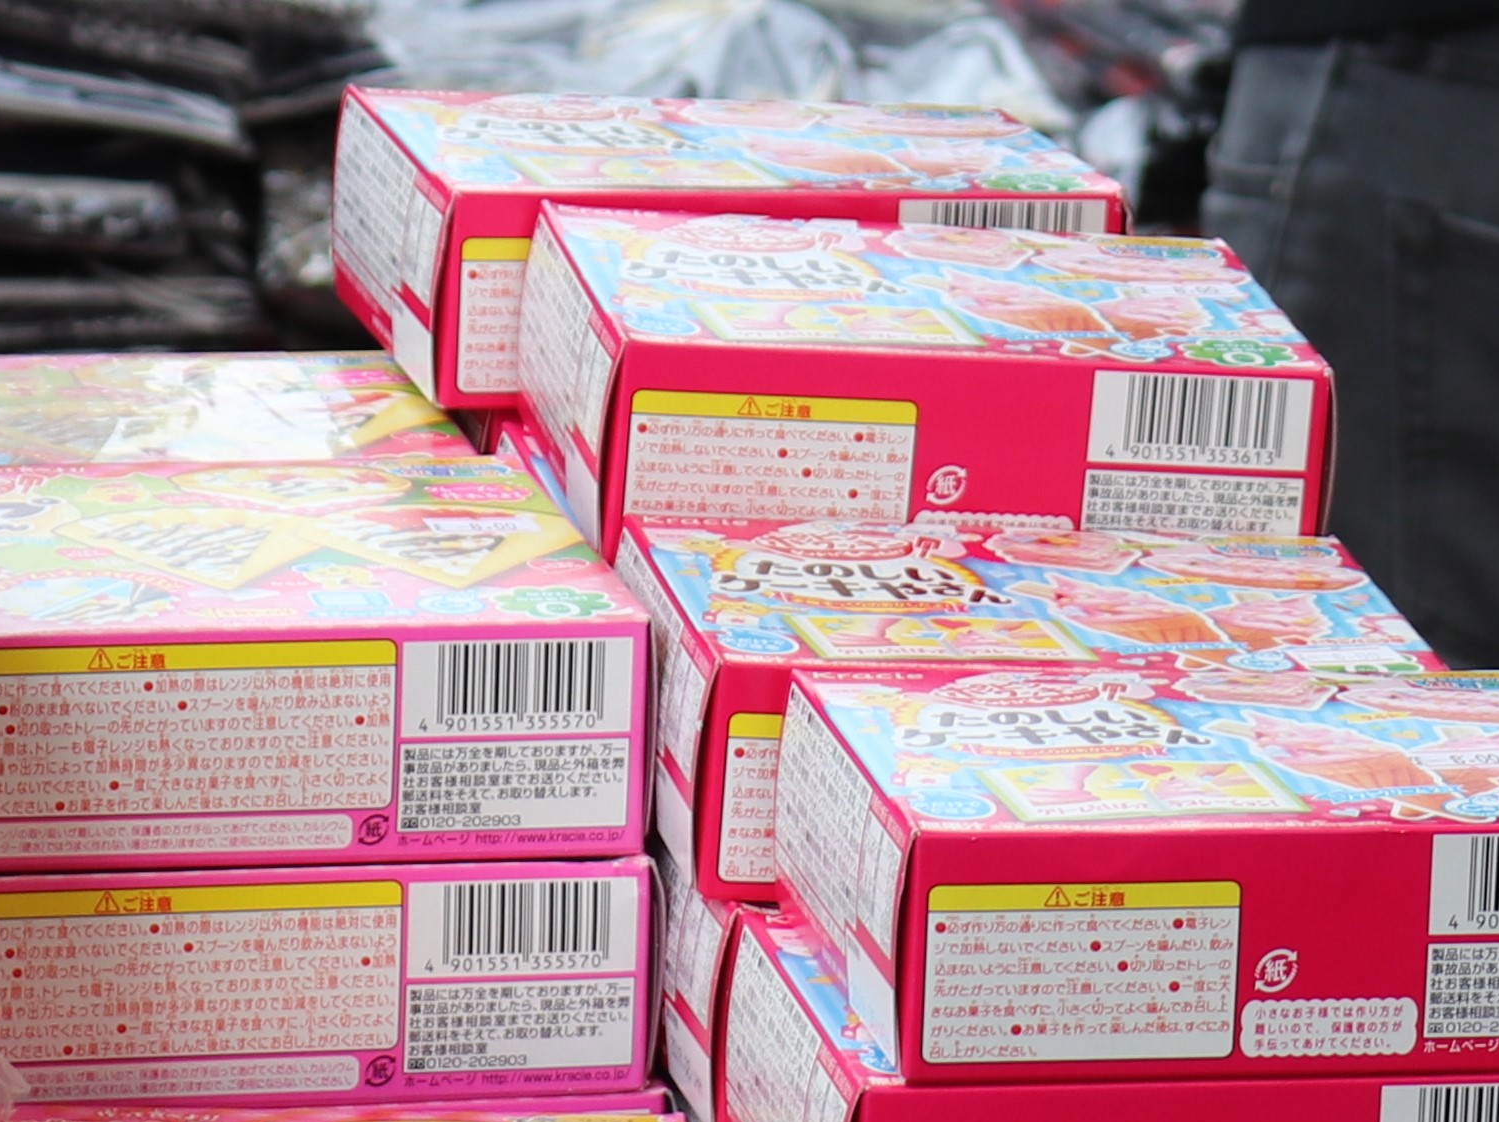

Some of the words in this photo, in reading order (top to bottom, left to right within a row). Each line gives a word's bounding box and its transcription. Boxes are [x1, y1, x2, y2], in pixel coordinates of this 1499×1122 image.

[1105, 447, 1115, 458] 4
[1130, 446, 1197, 461] 901551
[1207, 449, 1275, 465] 353613
[751, 559, 962, 583] たのしい
[718, 574, 1014, 606] ケーキやさん
[116, 653, 165, 670] ご注意
[419, 720, 428, 732] 4
[445, 716, 515, 730] 901551
[525, 714, 595, 730] 355570
[936, 708, 1156, 731] たのしい
[903, 722, 1214, 748] ケーキやさん
[1074, 891, 1125, 908] ご注意
[1449, 916, 1458, 928] 4
[1423, 1038, 1499, 1054] ホームページ
